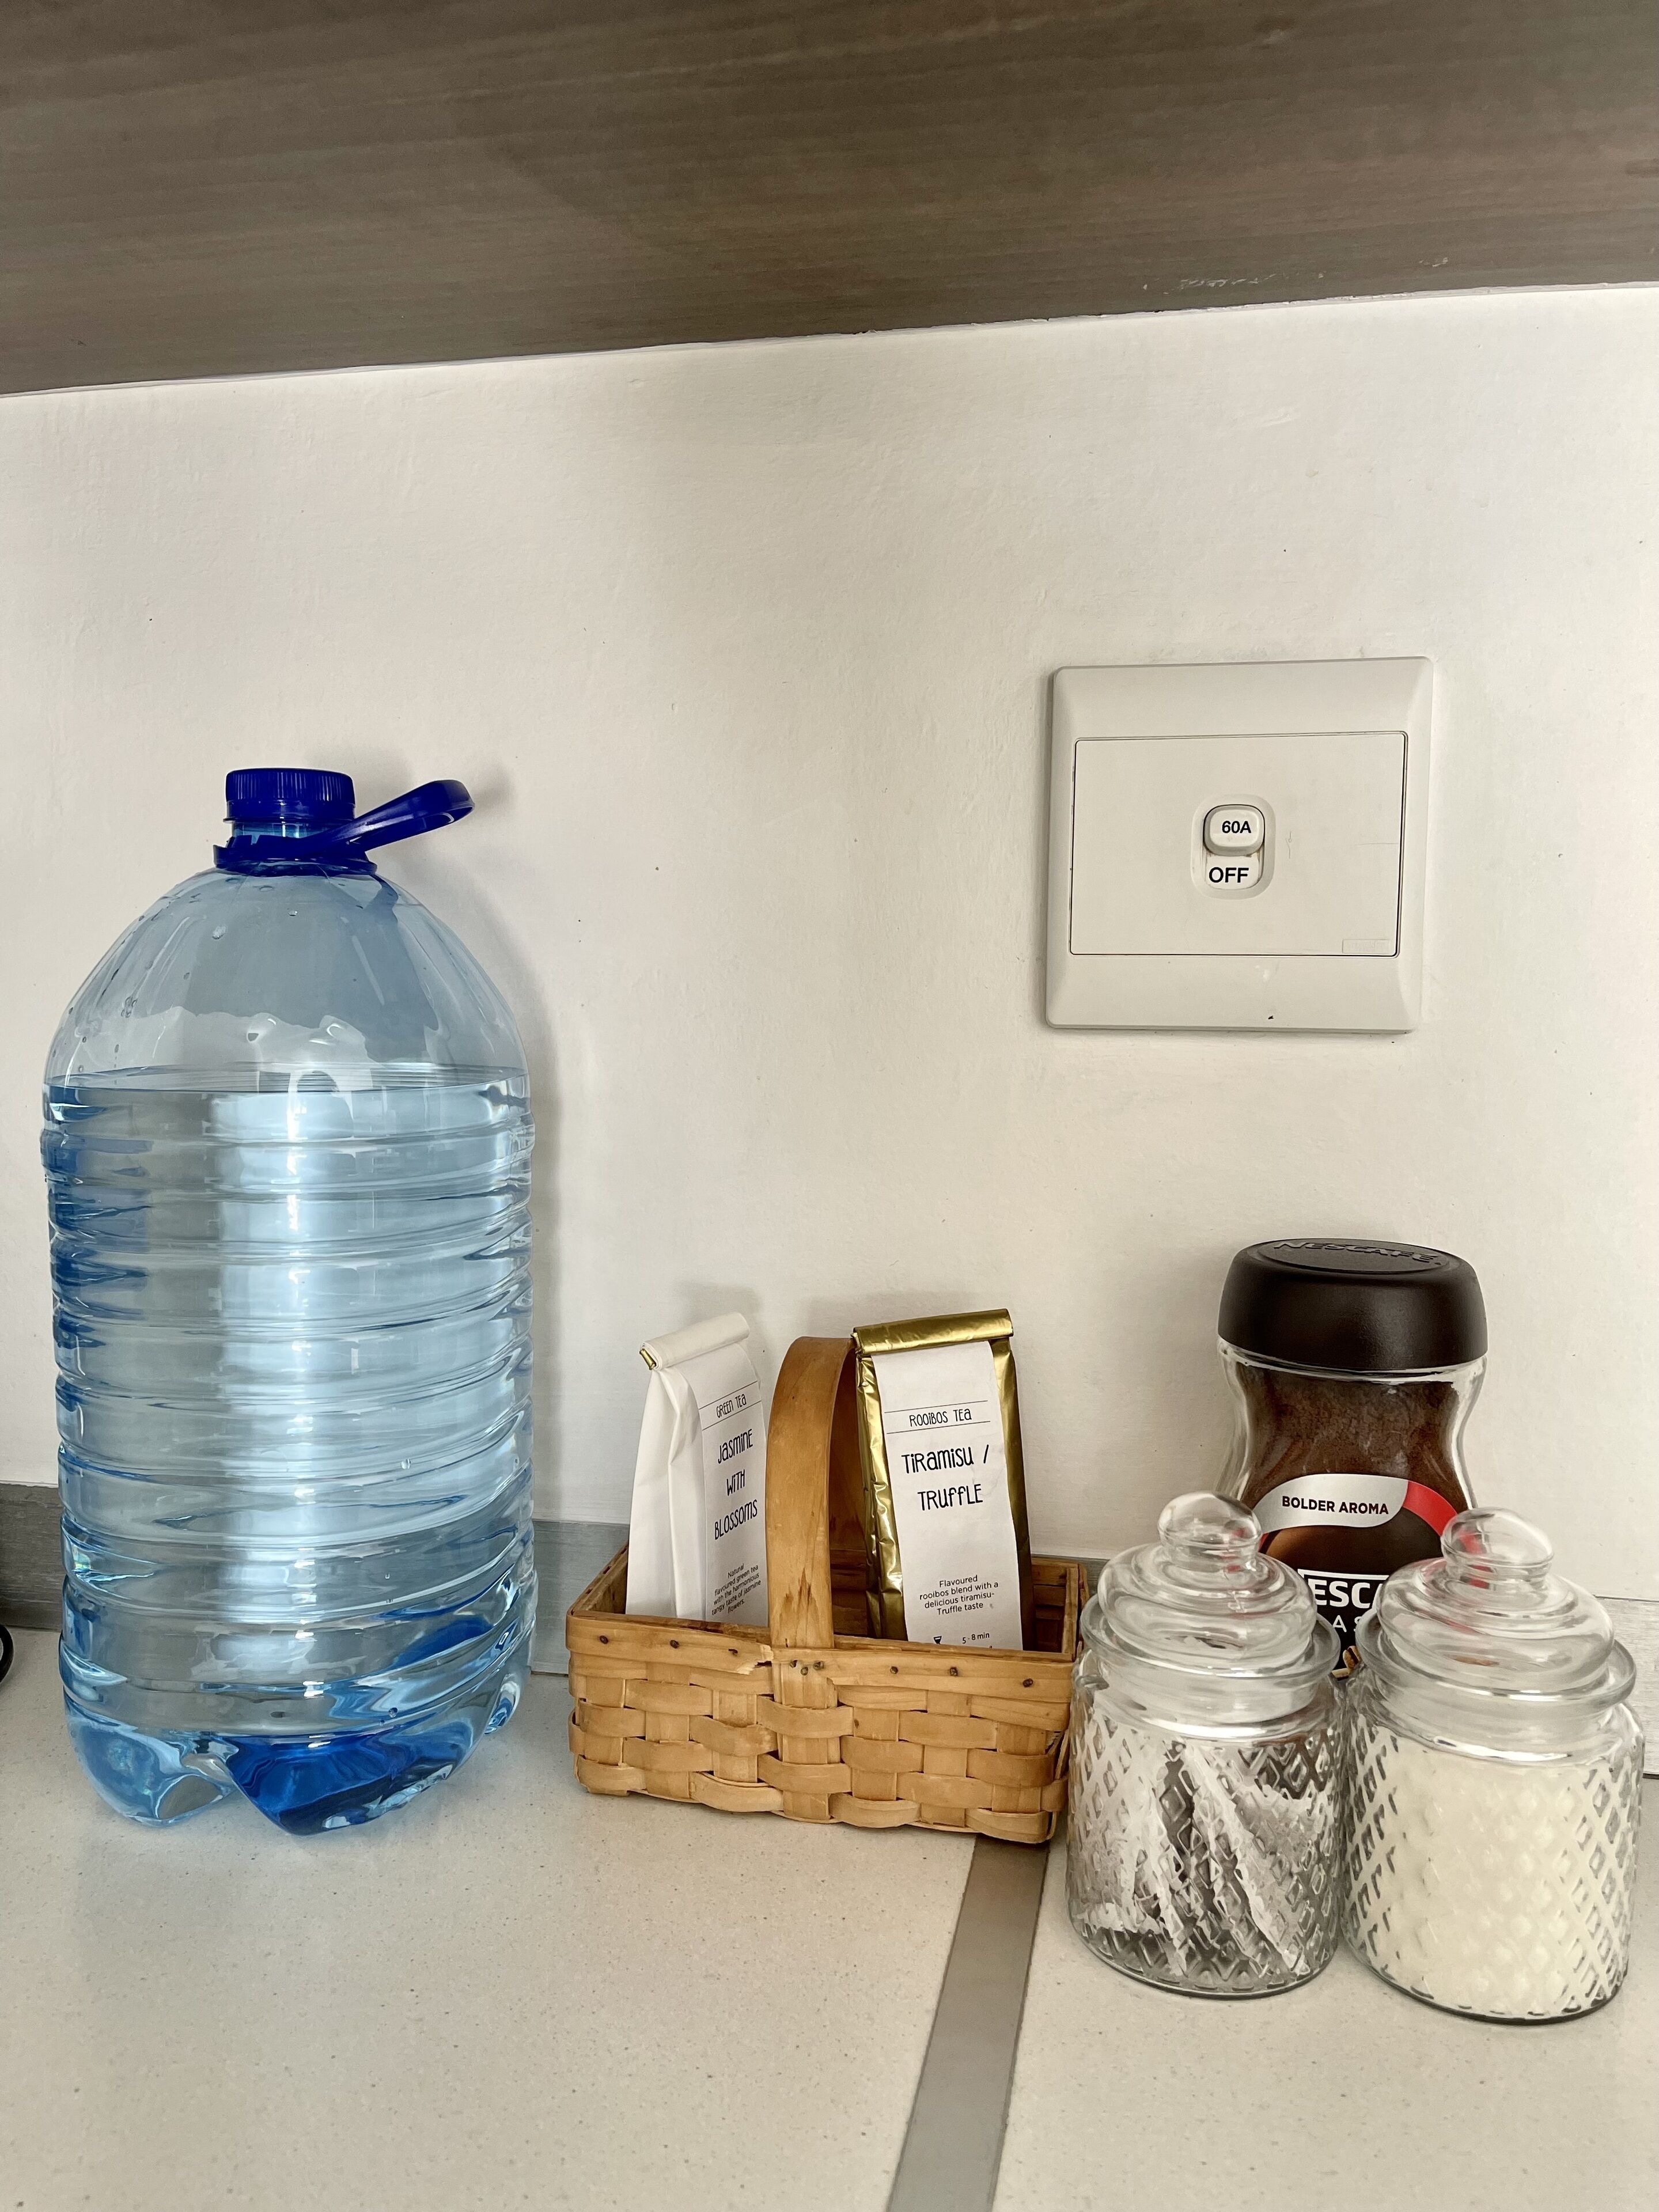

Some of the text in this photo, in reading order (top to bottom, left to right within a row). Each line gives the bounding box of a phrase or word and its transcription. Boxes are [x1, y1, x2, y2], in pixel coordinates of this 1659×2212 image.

[1222, 820, 1252, 834] 60A
[1209, 866, 1249, 883] OFF
[716, 1399, 733, 1418] GREEN
[983, 1444, 989, 1464] /
[1282, 1495, 1389, 1515] BOLDER AROMA
[728, 1563, 744, 1578] Natural
[736, 1570, 750, 1584] green
[751, 1565, 759, 1573] tea
[713, 1594, 724, 1605] with
[732, 1573, 759, 1593] harmonious
[939, 1574, 978, 1588] Flavoured
[711, 1580, 761, 1616] tangy taste of jasmine
[919, 1590, 949, 1601] rooibos
[951, 1585, 972, 1595] blend
[975, 1582, 992, 1591] with
[925, 1592, 995, 1609] delicious tiramisu-
[937, 1602, 984, 1616] Truffle taste
[977, 1631, 990, 1640] min
